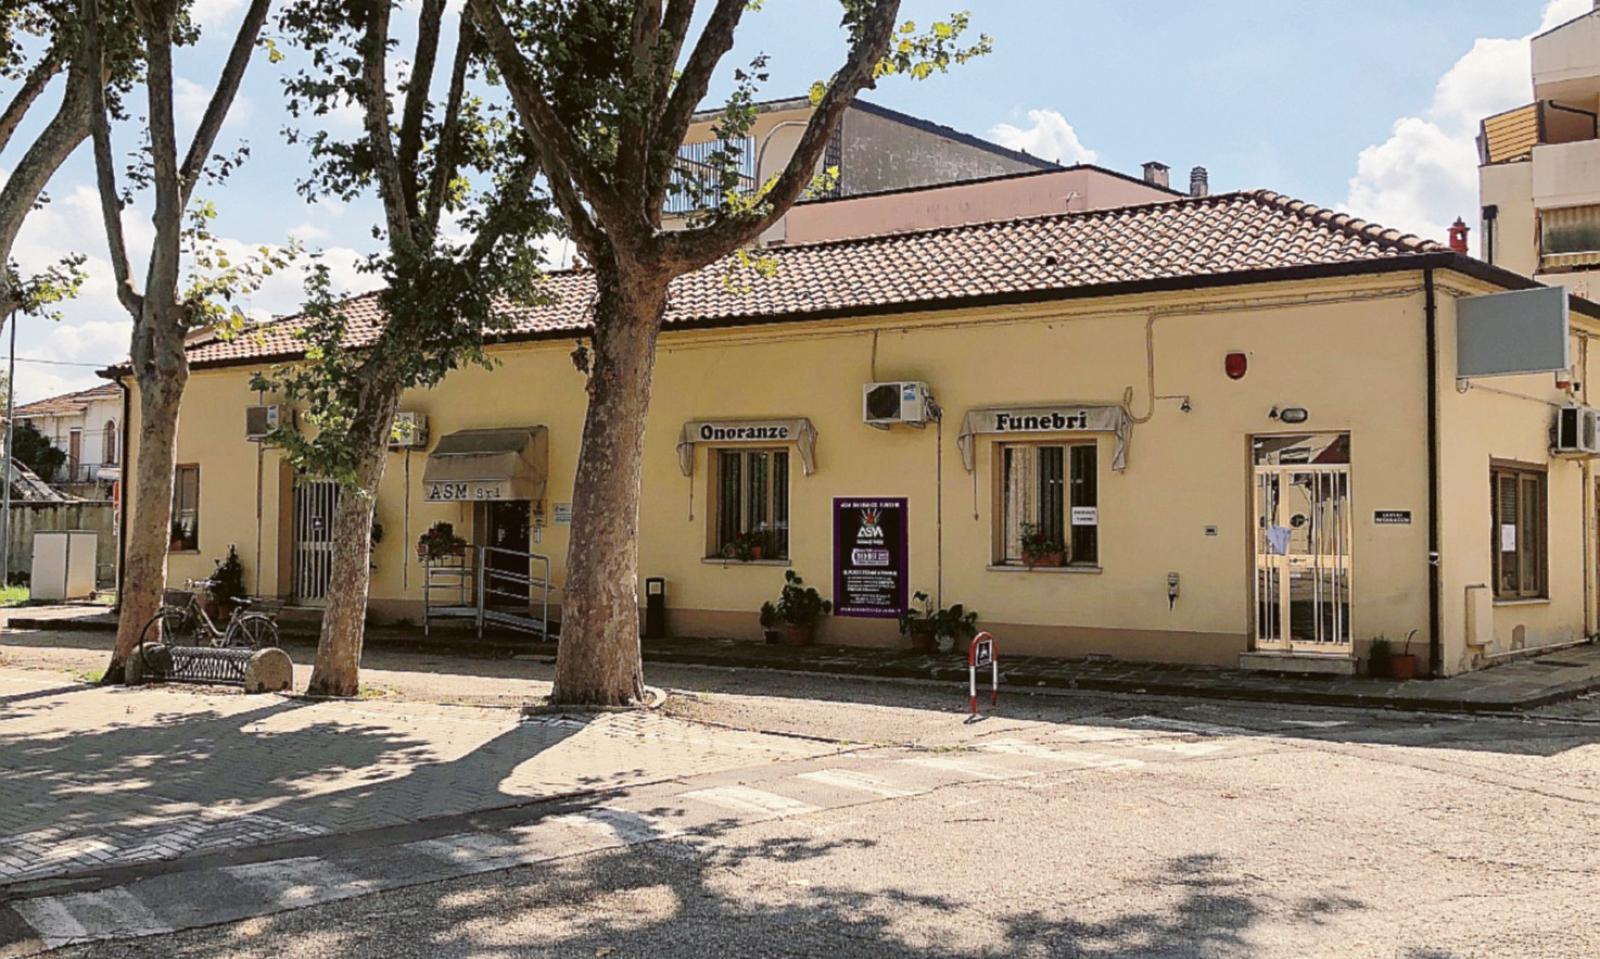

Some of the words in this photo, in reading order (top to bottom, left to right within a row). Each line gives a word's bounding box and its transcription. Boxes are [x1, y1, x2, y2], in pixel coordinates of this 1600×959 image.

[996, 411, 1087, 431] Funebri
[700, 424, 788, 440] Onoranze
[430, 483, 468, 499] ASM
[857, 526, 884, 538] ASM
